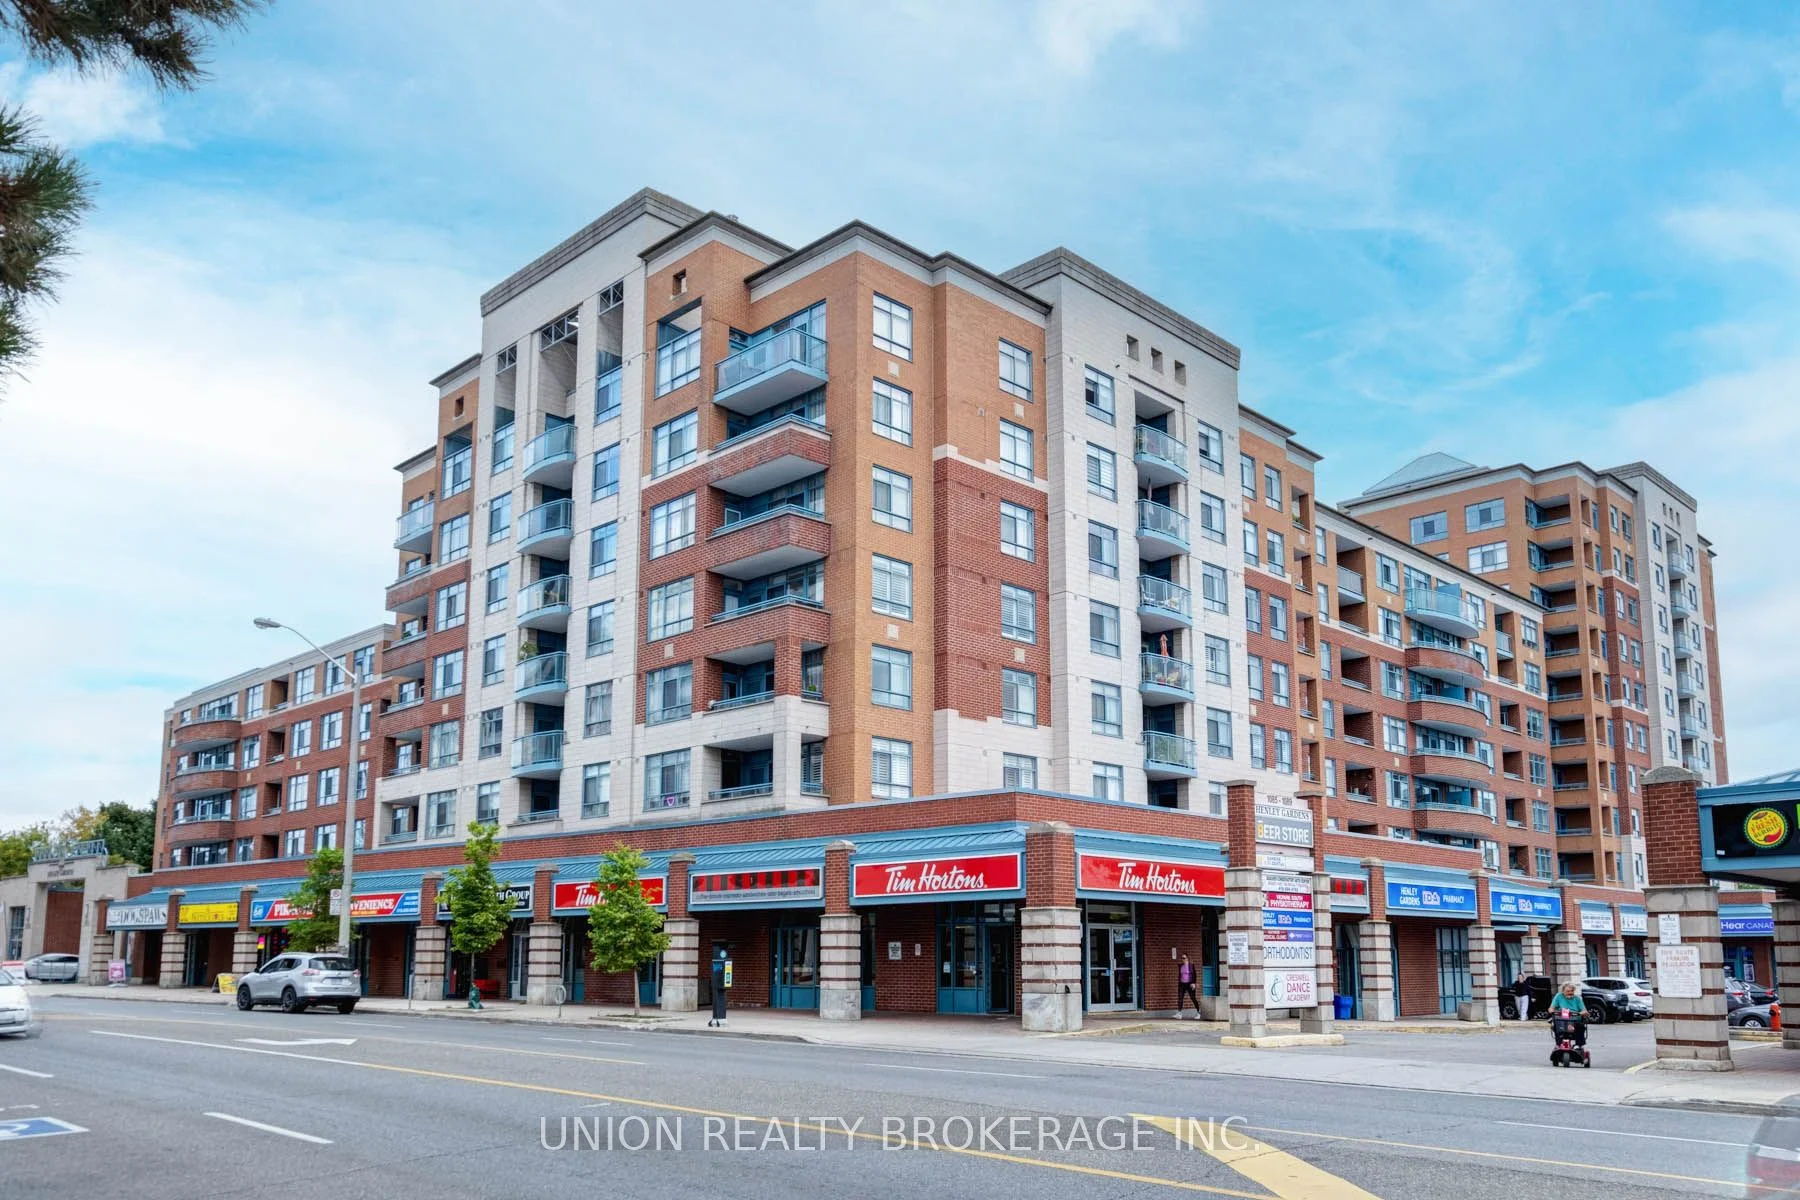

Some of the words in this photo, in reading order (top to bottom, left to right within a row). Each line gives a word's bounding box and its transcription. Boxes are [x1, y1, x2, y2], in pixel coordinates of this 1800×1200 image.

[1256, 805, 1280, 816] HENLEY
[1281, 808, 1310, 819] GARDENS
[1281, 826, 1310, 843] STORE
[885, 865, 915, 893] Tim
[918, 863, 985, 891] Hortons
[1118, 862, 1144, 889] Tim
[1145, 863, 1196, 893] Hortons
[575, 884, 597, 907] Tim
[1400, 887, 1418, 896] HENLEY
[350, 898, 394, 912] VENIENCE
[1270, 900, 1310, 909] PHYSIOTHERAPY
[1400, 896, 1420, 906] GARDENS
[1442, 895, 1465, 904] PHARMACY
[1263, 946, 1312, 959] ORTHODONTIST
[1287, 982, 1311, 992] DANCE
